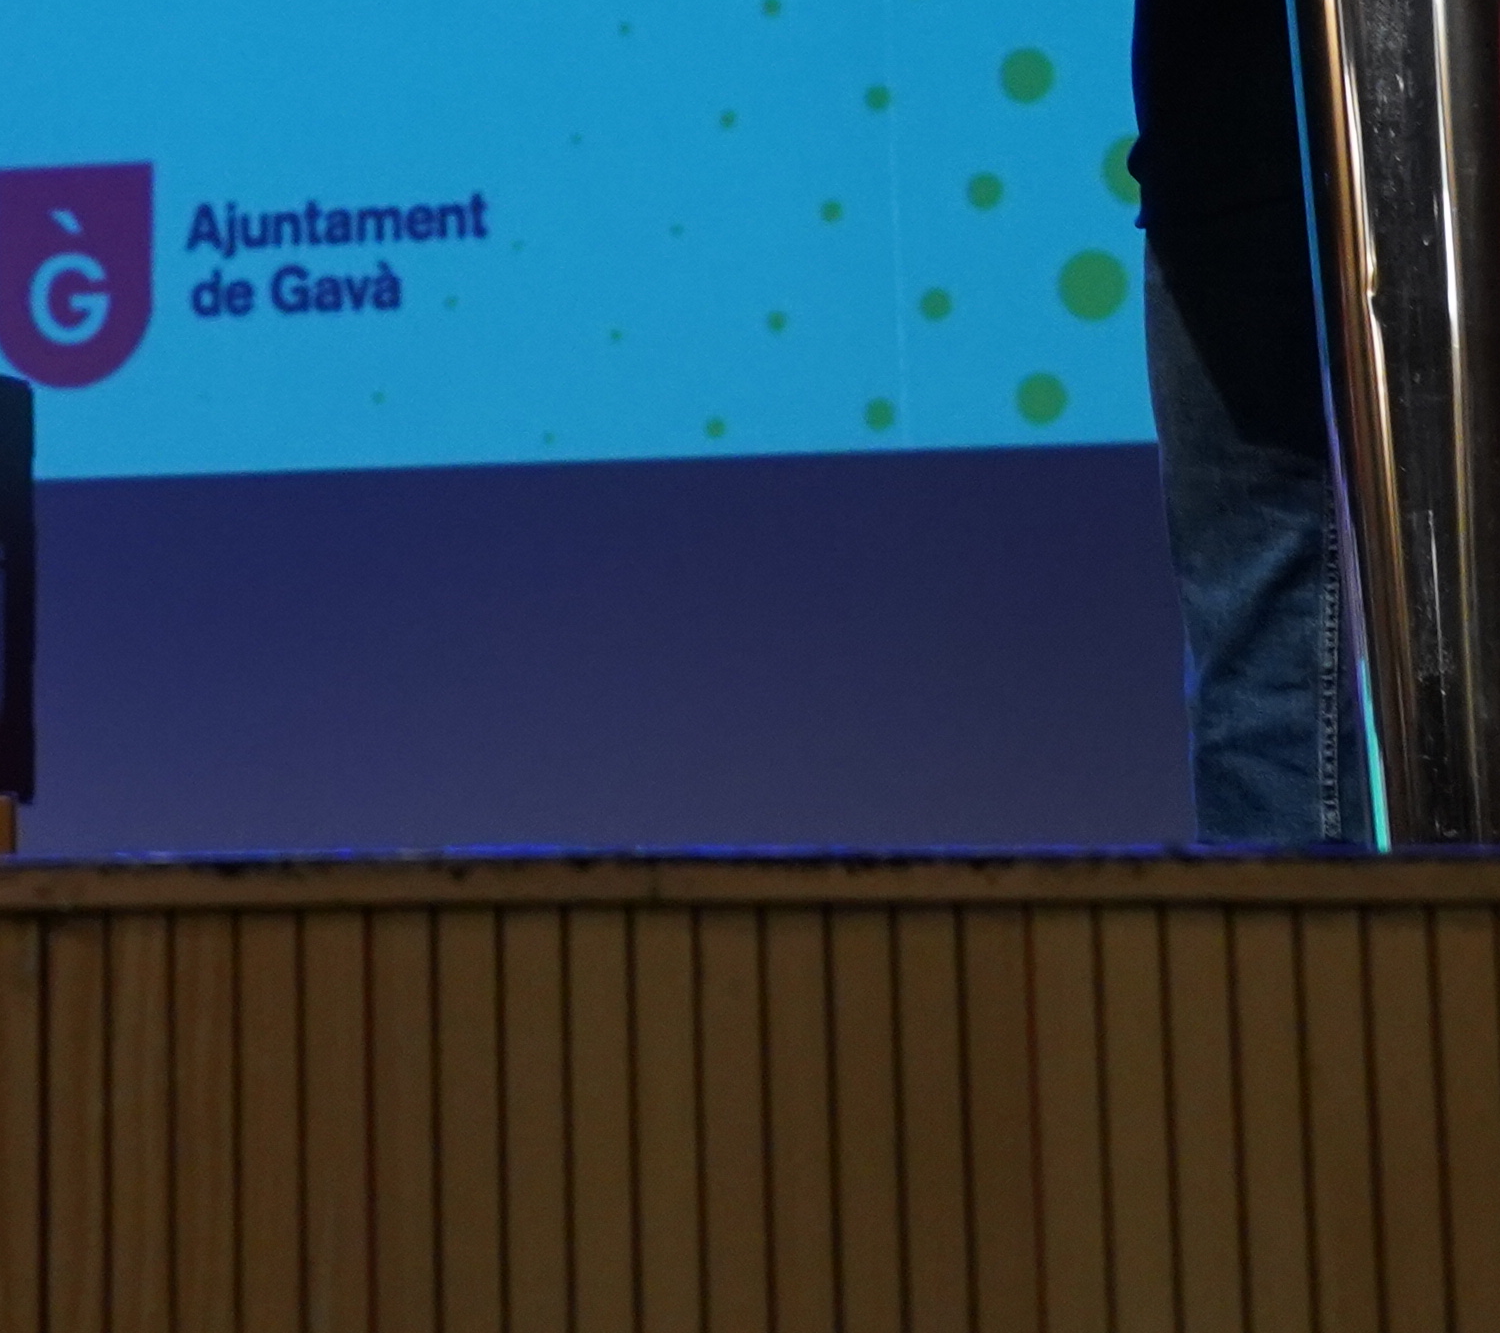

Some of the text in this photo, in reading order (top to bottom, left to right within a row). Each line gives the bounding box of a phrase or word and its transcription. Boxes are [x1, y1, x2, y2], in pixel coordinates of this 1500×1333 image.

[186, 191, 490, 258] Ajuntament
[190, 261, 402, 318] de Gavà
